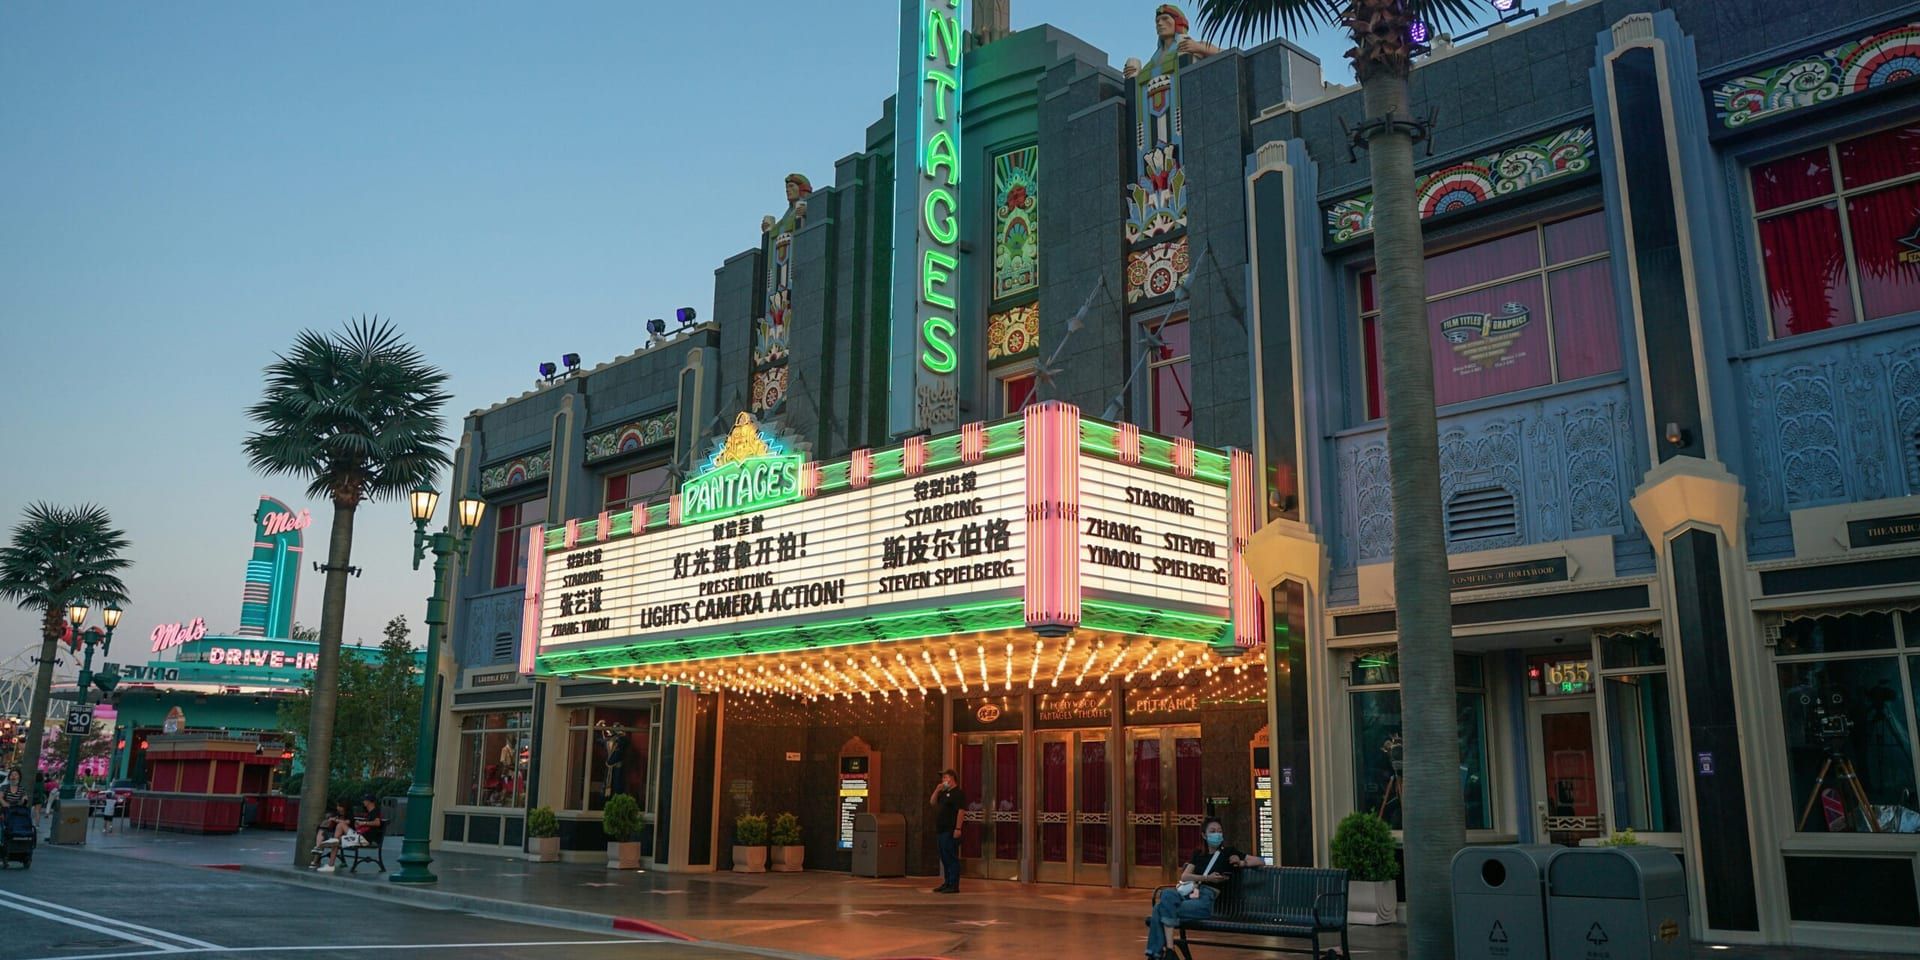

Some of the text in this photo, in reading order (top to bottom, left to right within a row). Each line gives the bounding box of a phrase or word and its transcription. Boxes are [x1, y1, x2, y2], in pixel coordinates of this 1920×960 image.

[922, 0, 958, 373] NTAGES
[1443, 318, 1459, 330] FILM
[1460, 316, 1482, 327] TITLES
[1493, 314, 1527, 330] GRAPHICS
[685, 461, 796, 516] PANTAGES
[1124, 486, 1195, 516] STARRING
[262, 507, 313, 537] Mel's
[904, 497, 983, 528] STARRING
[882, 517, 1011, 570] 斯皮尔伯格
[1086, 517, 1143, 545] ZHANG
[1163, 532, 1216, 558] STEVEN
[1087, 544, 1141, 571] YIMOU
[1152, 555, 1227, 586] SPIELBERG
[562, 569, 604, 588] STARRING
[699, 571, 774, 597] PRESENTING
[879, 558, 1015, 594] STEVEN SPIELBERG
[1508, 567, 1555, 579] HOLLYWOOD
[559, 586, 603, 618] 张艺谋
[640, 578, 845, 629] LIGHTS CAMERA ACTION!
[151, 617, 208, 653] Mel's
[551, 617, 610, 637] ZHANG YIMOU
[209, 647, 319, 670] DRIVE-IN
[1550, 662, 1590, 685] 655
[1136, 697, 1200, 712] ENTRANCE
[69, 712, 90, 726] 30
